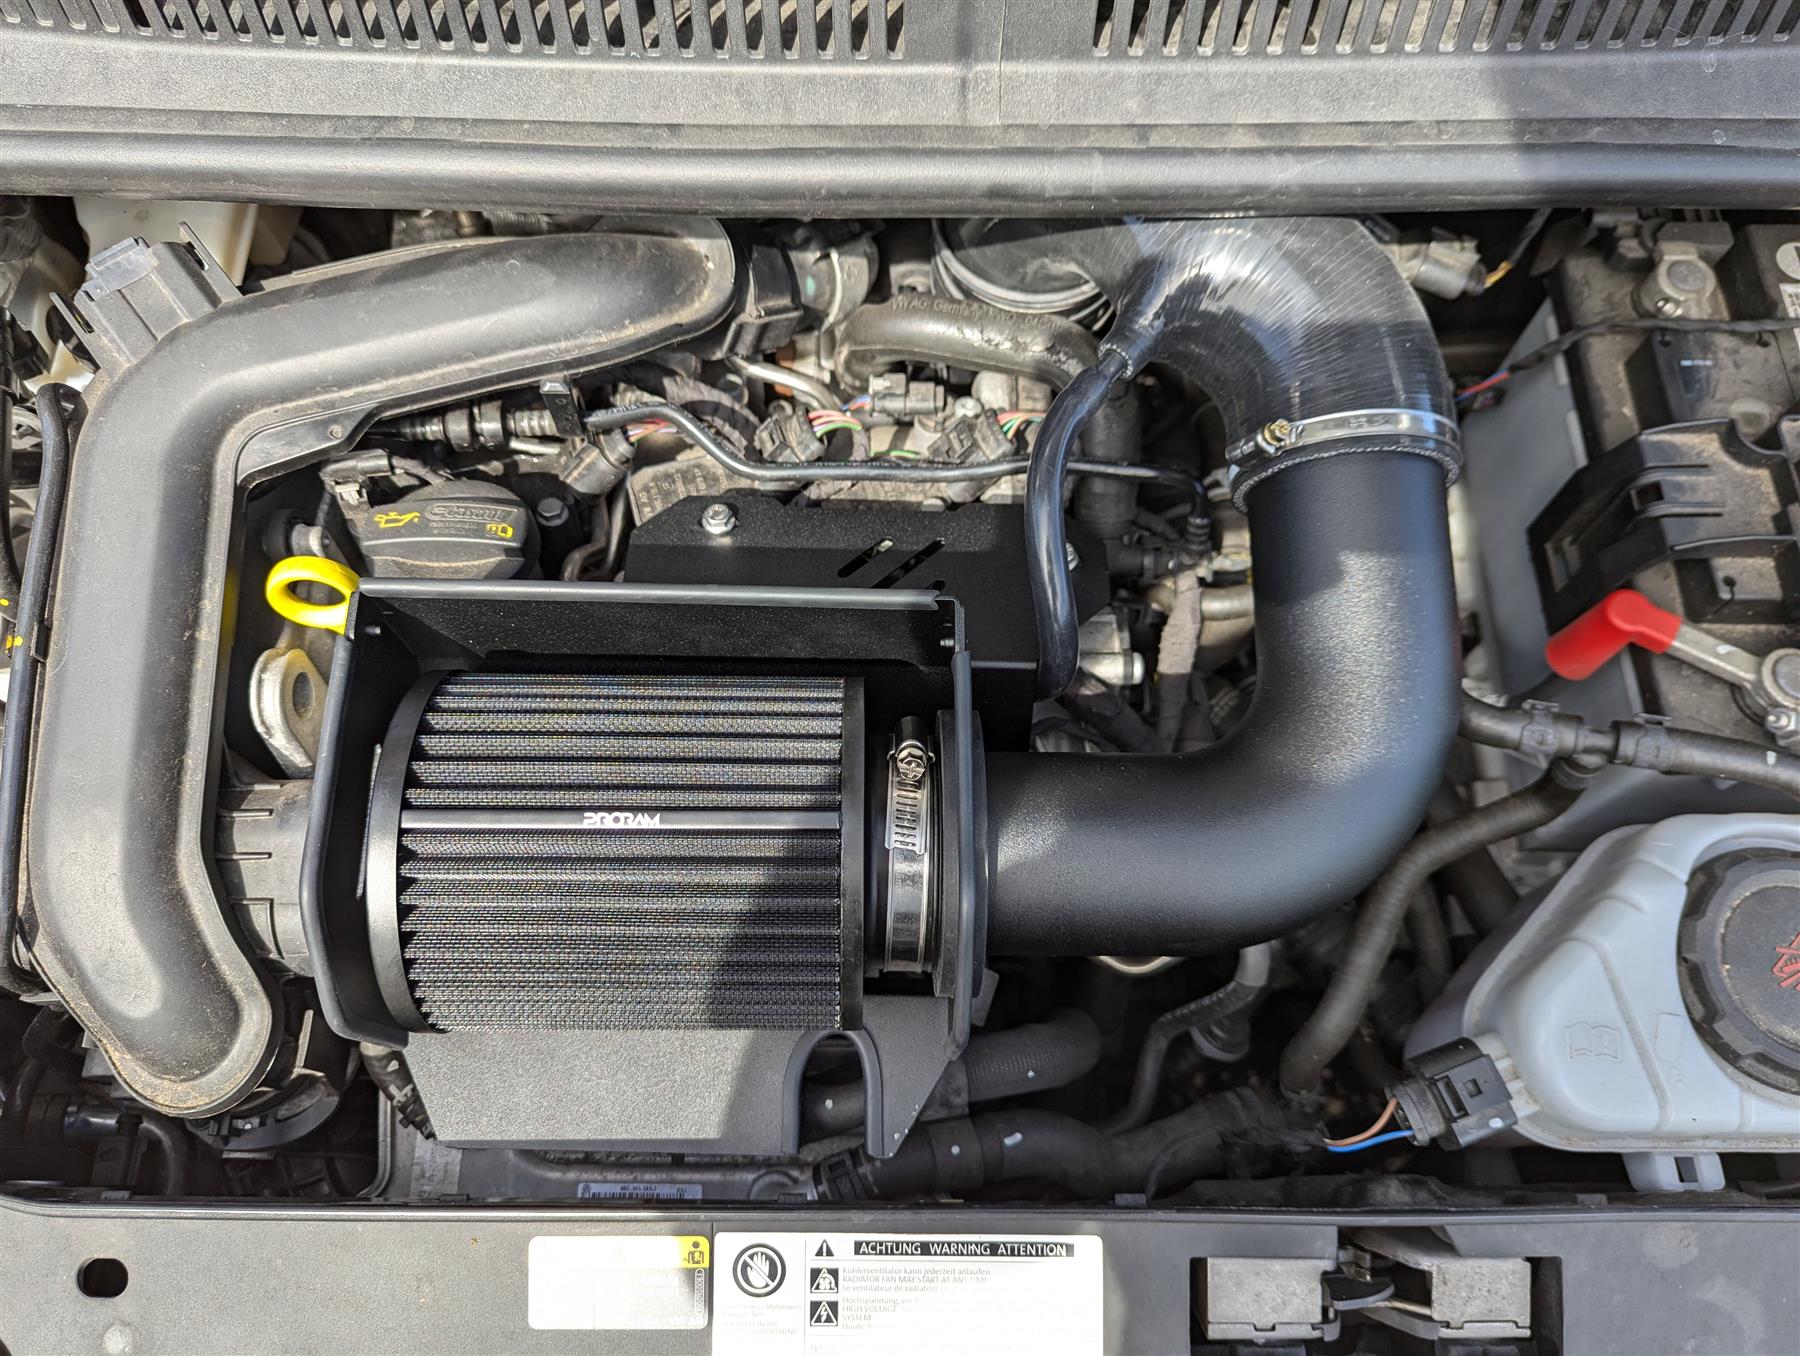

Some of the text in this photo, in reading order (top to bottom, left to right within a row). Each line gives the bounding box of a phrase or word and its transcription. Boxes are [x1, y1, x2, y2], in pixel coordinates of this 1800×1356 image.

[583, 812, 661, 827] PRORAM
[860, 1242, 1067, 1257] ACHTUNG WARNING ATTENTION
[904, 1266, 922, 1275] kann
[923, 1266, 956, 1277] jederzeit
[842, 1275, 881, 1284] RADIATOR
[882, 1275, 897, 1284] FAN
[898, 1275, 916, 1284] MAY
[917, 1275, 939, 1285] START
[941, 1276, 951, 1285] AT
[853, 1284, 892, 1293] ventilateur
[894, 1284, 904, 1293] de
[842, 1304, 863, 1313] HIGH
[842, 1313, 872, 1322] SYSTEM
